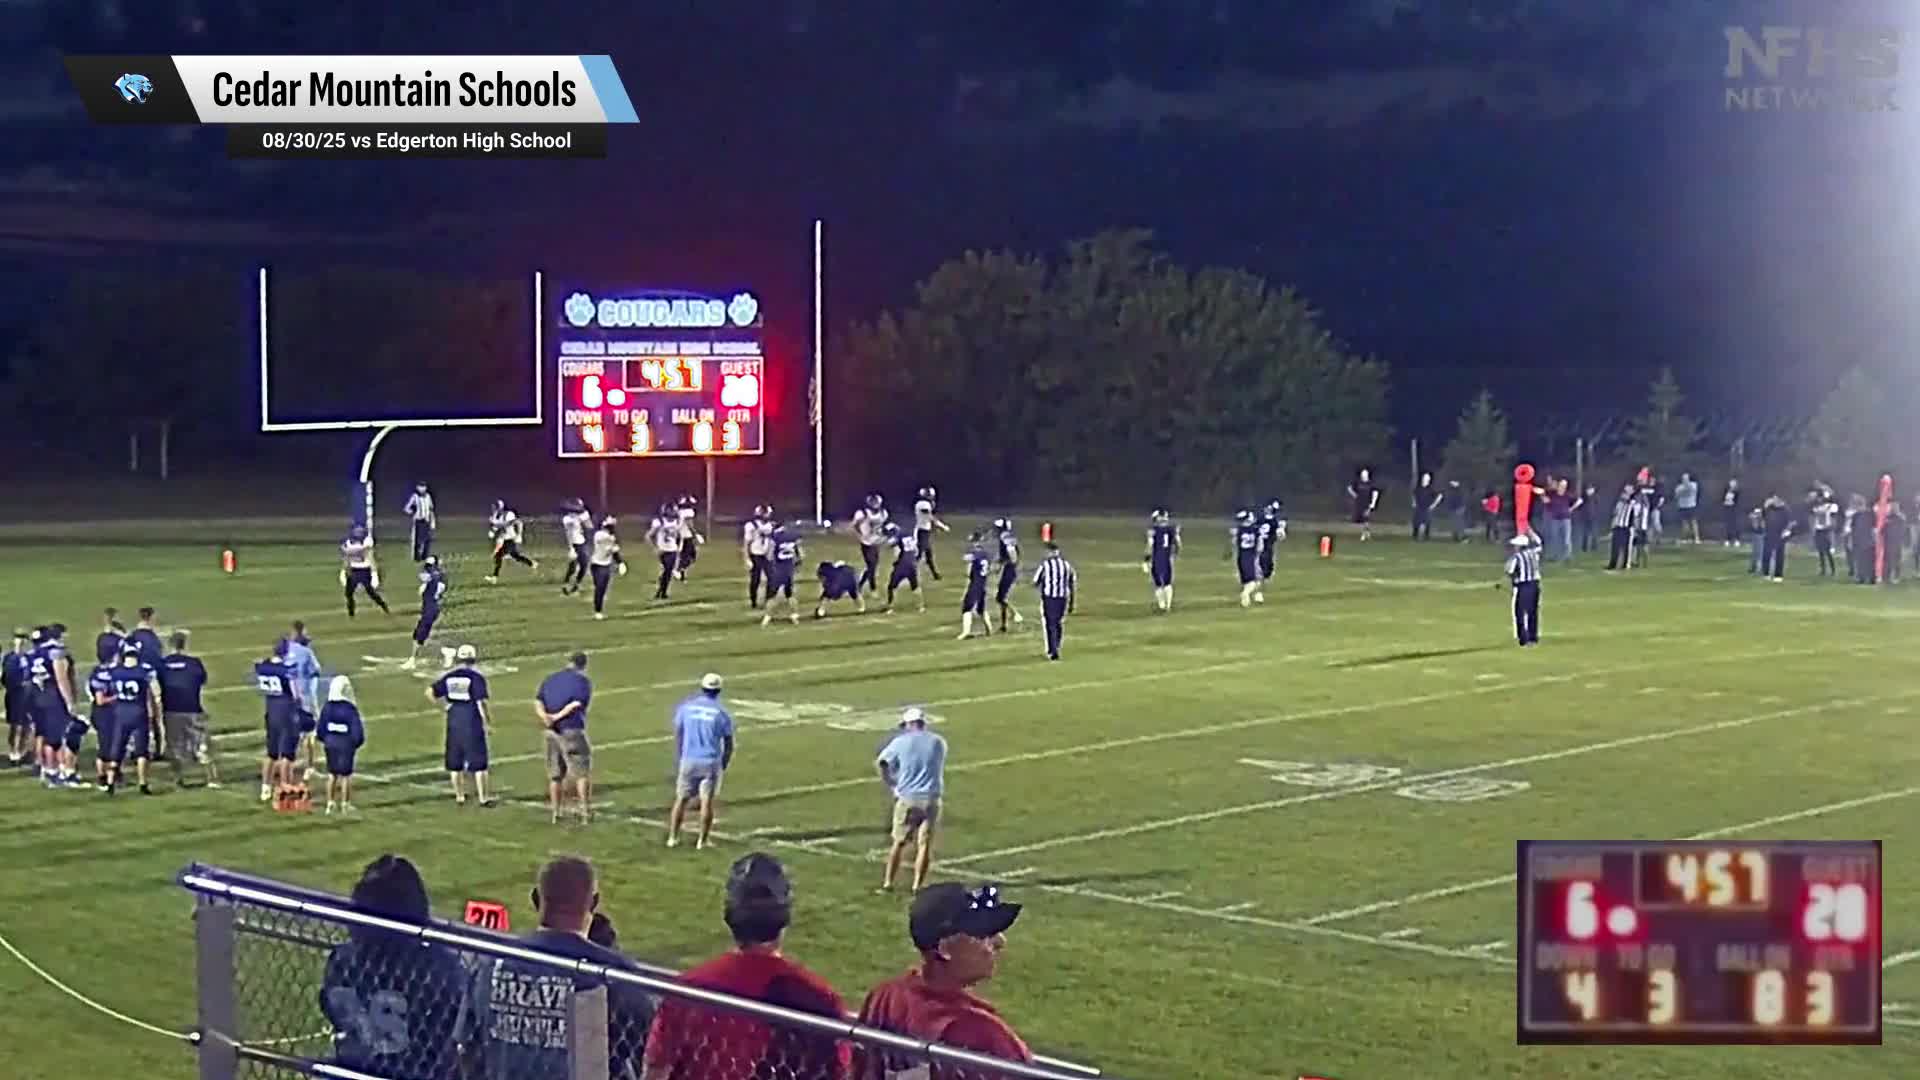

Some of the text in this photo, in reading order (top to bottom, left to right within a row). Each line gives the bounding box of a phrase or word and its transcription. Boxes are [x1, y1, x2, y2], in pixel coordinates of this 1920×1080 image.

[598, 299, 726, 327] COUGARS
[720, 361, 759, 375] GUEST
[582, 375, 603, 408] 6
[565, 409, 602, 424] DOWN
[613, 409, 648, 424] TO GO
[672, 409, 698, 424] BALL
[582, 424, 604, 452] 4
[631, 422, 650, 453] 3
[722, 422, 741, 453] 3
